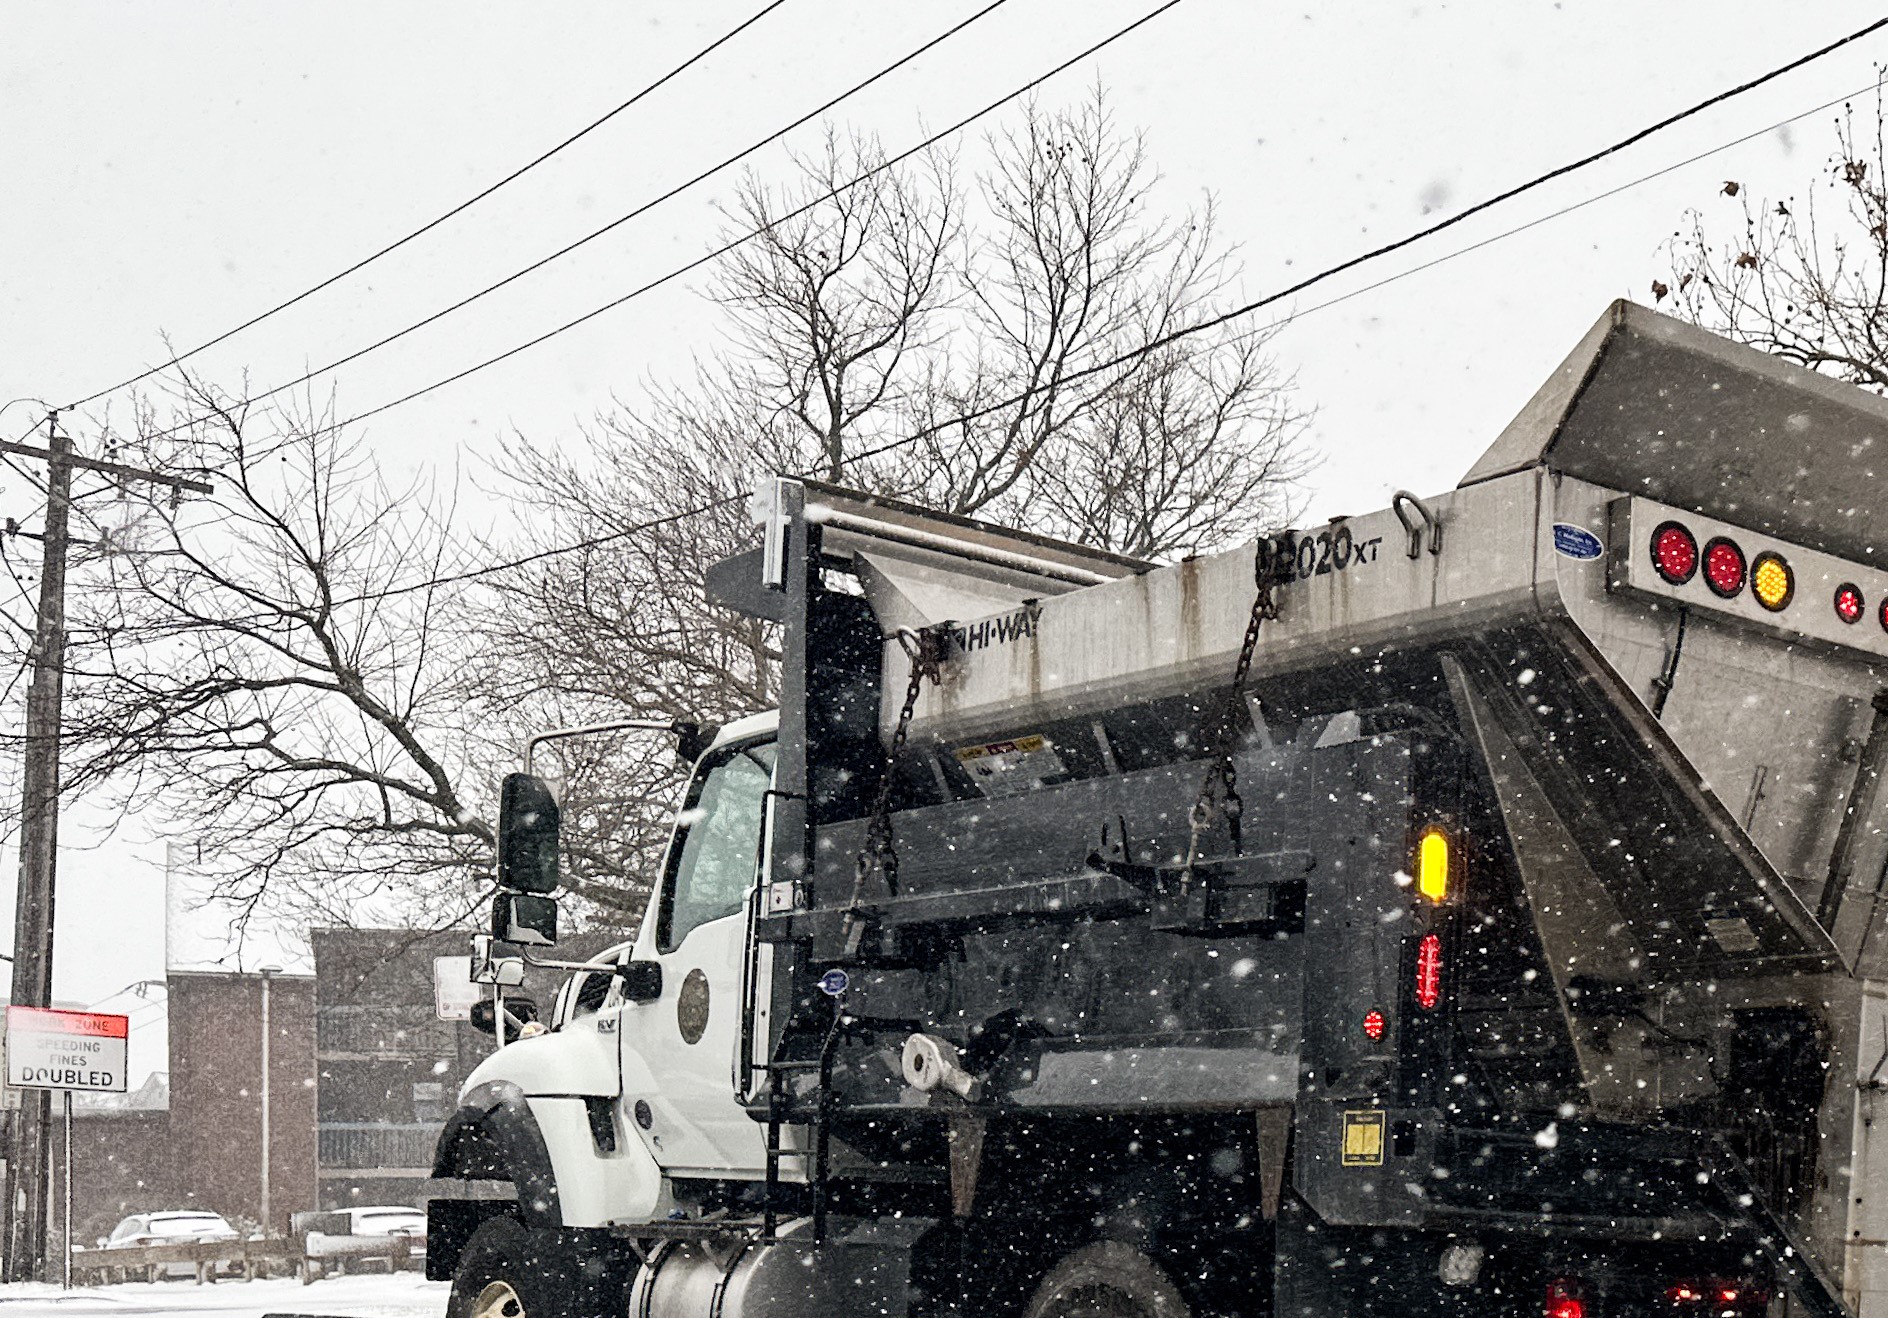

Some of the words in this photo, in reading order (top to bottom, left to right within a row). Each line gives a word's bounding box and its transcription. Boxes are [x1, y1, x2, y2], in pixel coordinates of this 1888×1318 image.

[75, 1019, 109, 1032] ZONE
[37, 1040, 100, 1053] SPEEDING
[50, 1054, 87, 1066] FINES
[22, 1067, 113, 1086] DOUBLED
